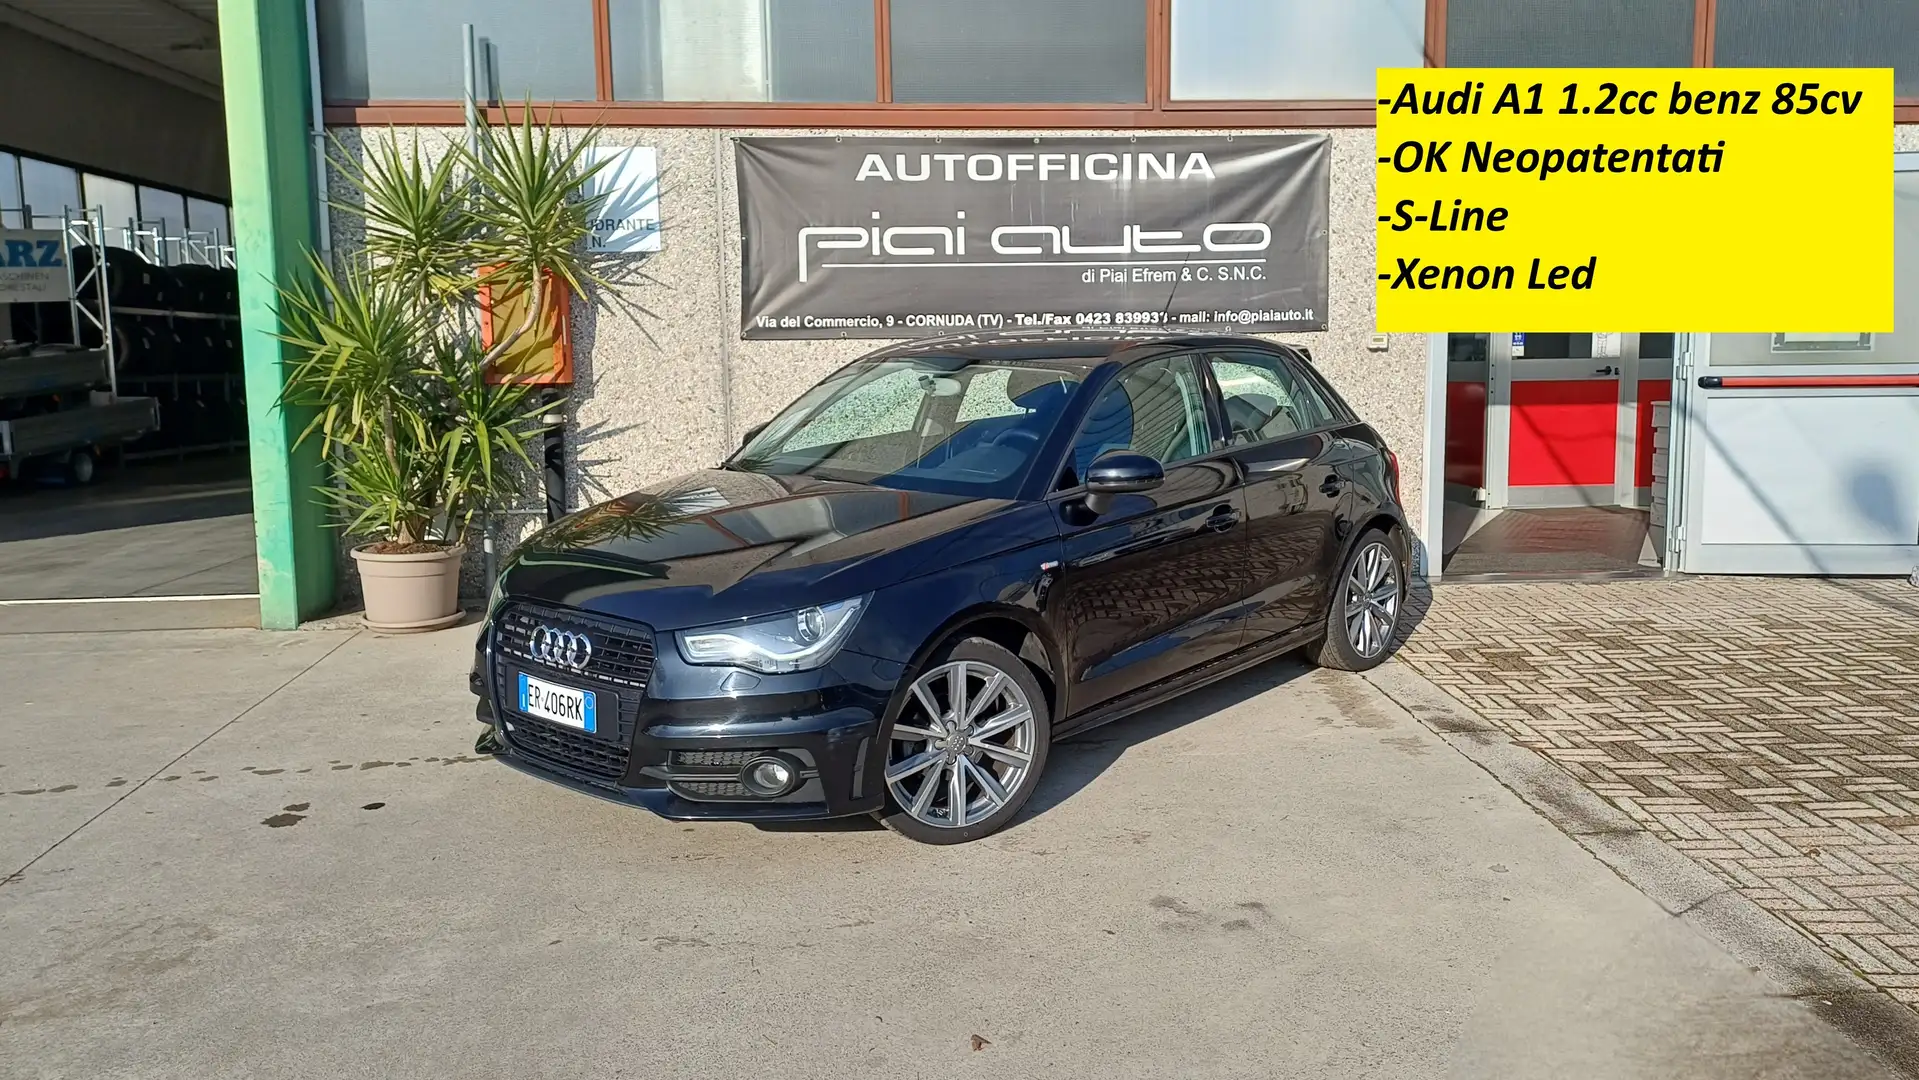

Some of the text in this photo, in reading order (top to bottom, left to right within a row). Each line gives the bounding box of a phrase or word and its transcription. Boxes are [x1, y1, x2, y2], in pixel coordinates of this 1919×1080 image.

[855, 152, 1216, 182] AUTOFFICINA
[592, 236, 606, 249] N.
[1081, 266, 1267, 283] di Piai Efrem & C. S.N.C.
[756, 316, 777, 328] Via
[780, 316, 800, 328] del
[804, 315, 883, 328] Commercio,
[886, 316, 895, 327] 9
[906, 315, 974, 327] CORNUDA
[977, 314, 1003, 328] (TV)
[1015, 313, 1071, 325] Tel./Fax
[1075, 312, 1111, 325] 0423
[1180, 311, 1210, 323] mail:
[1213, 309, 1314, 324] info@piaiauto.it
